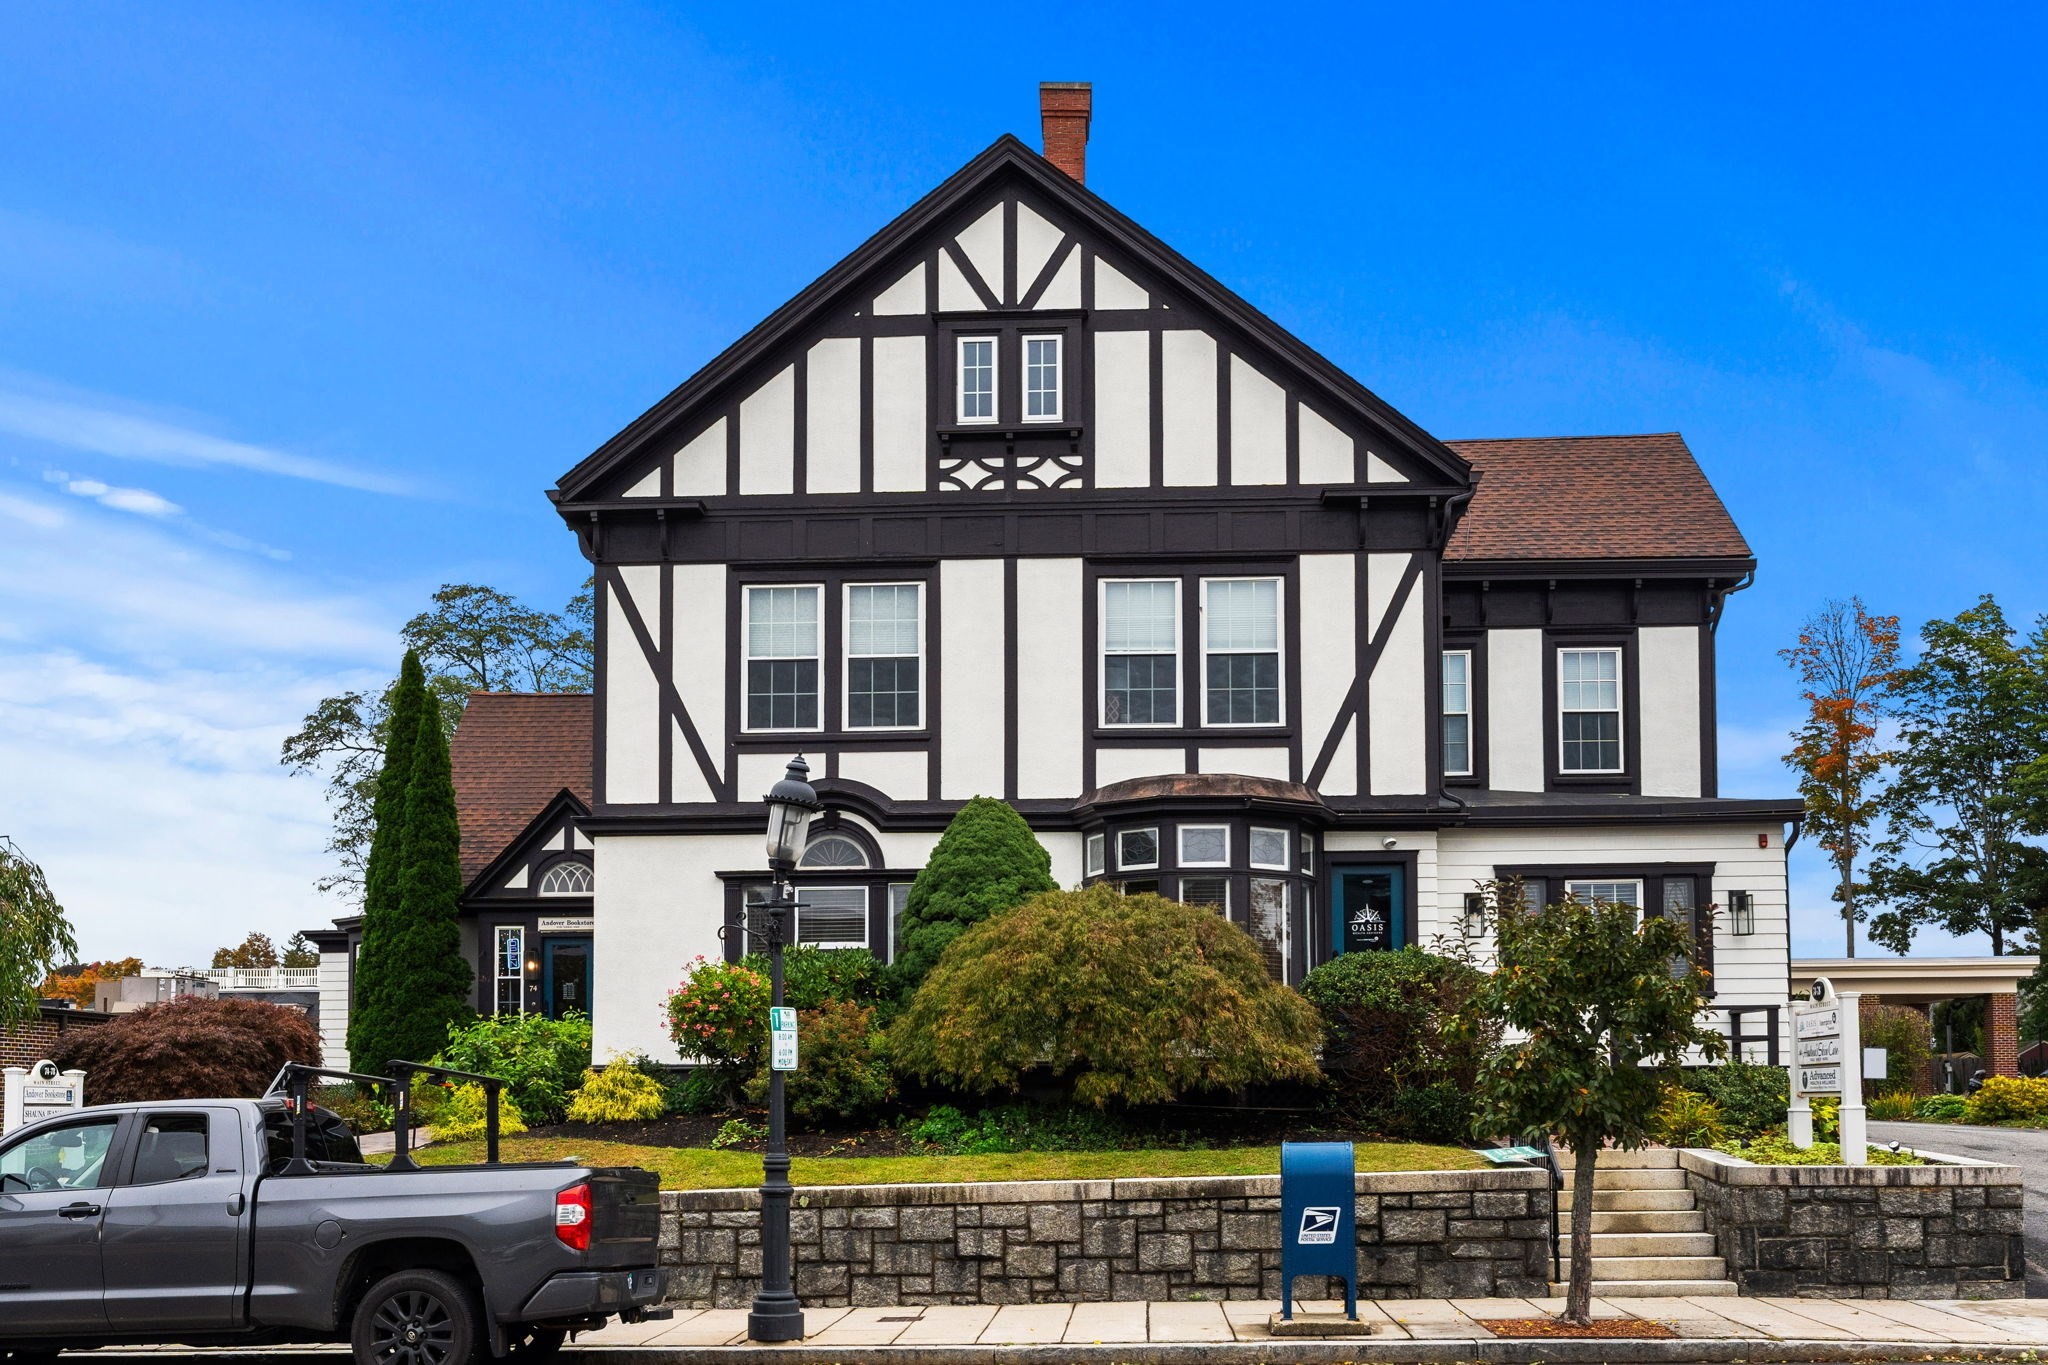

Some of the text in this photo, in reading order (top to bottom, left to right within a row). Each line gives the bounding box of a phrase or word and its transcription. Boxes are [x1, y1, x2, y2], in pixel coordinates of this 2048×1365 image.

[1351, 923, 1384, 932] OASIS
[1809, 1069, 1836, 1081] Advanced
[25, 1089, 66, 1099] Andover Bookstore
[25, 1110, 46, 1118] SHAUNA
